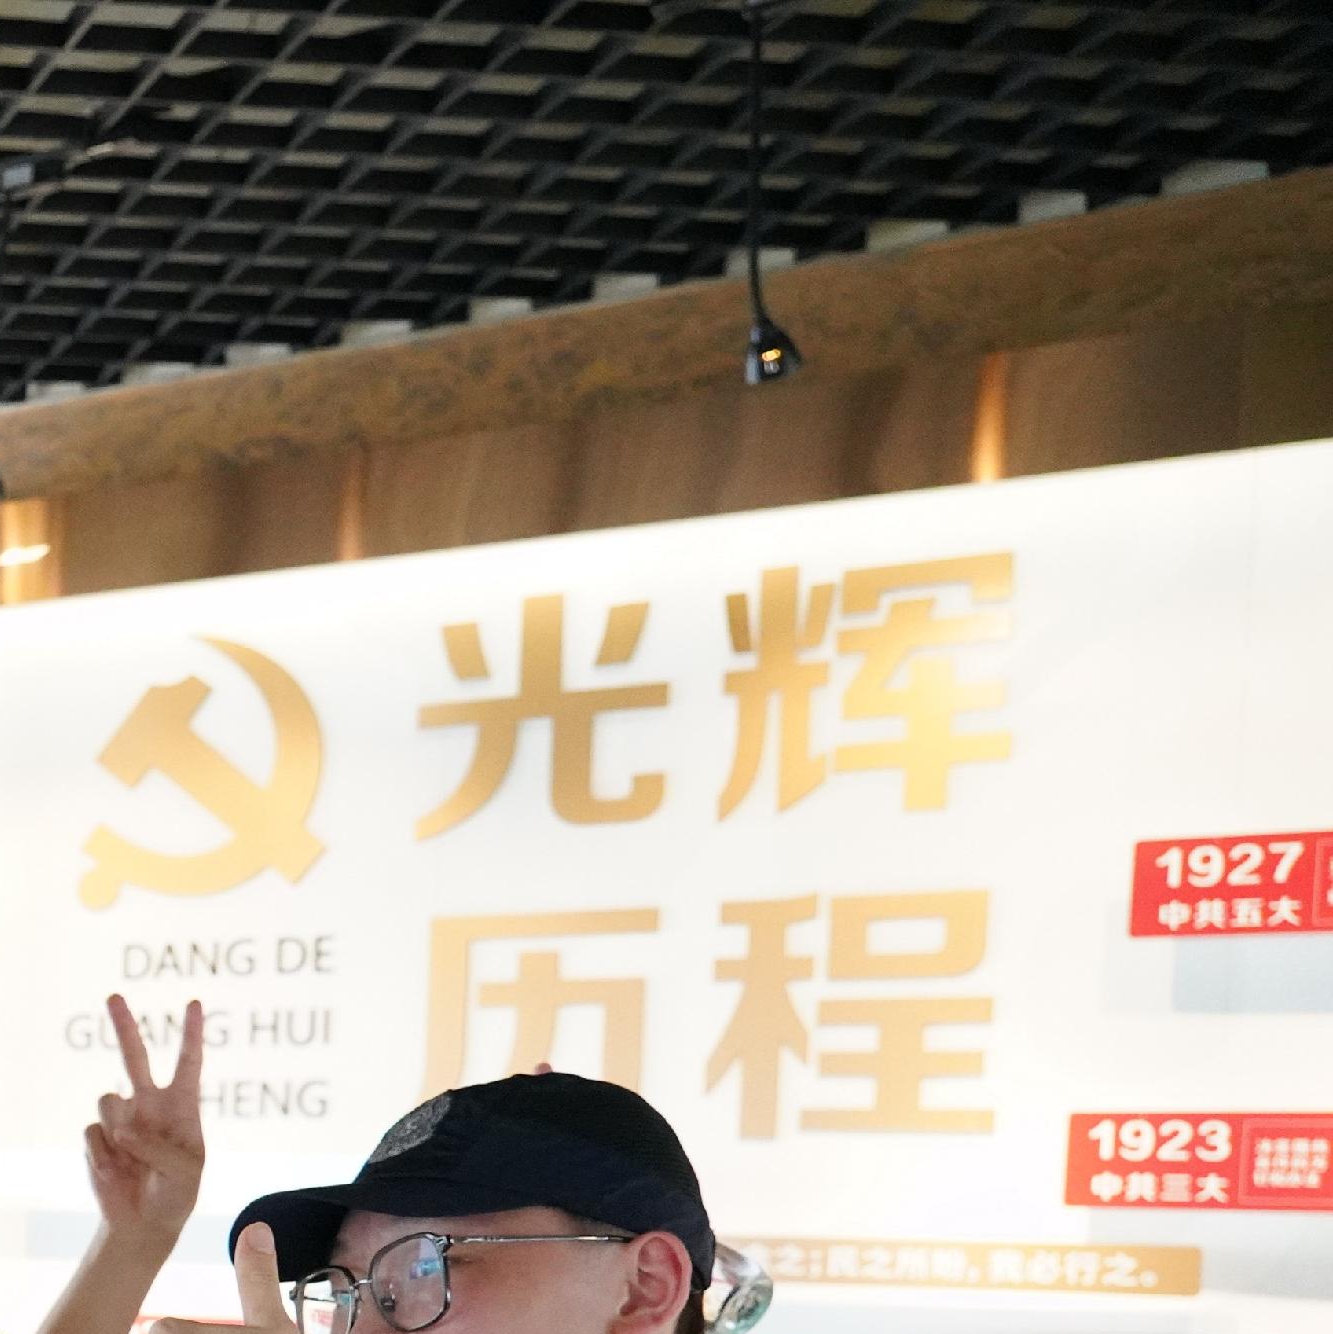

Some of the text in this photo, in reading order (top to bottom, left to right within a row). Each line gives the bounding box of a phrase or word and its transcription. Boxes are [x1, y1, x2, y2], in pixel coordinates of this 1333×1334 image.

[413, 552, 1014, 841] 光辉
[1154, 841, 1305, 889] 1927
[1157, 895, 1303, 932] 中共五大
[122, 935, 336, 979] DANG DE
[249, 1009, 332, 1046] HUI
[420, 890, 996, 1141] 历程
[1087, 1118, 1233, 1163] 1923
[1090, 1171, 1230, 1203] 中共三大
